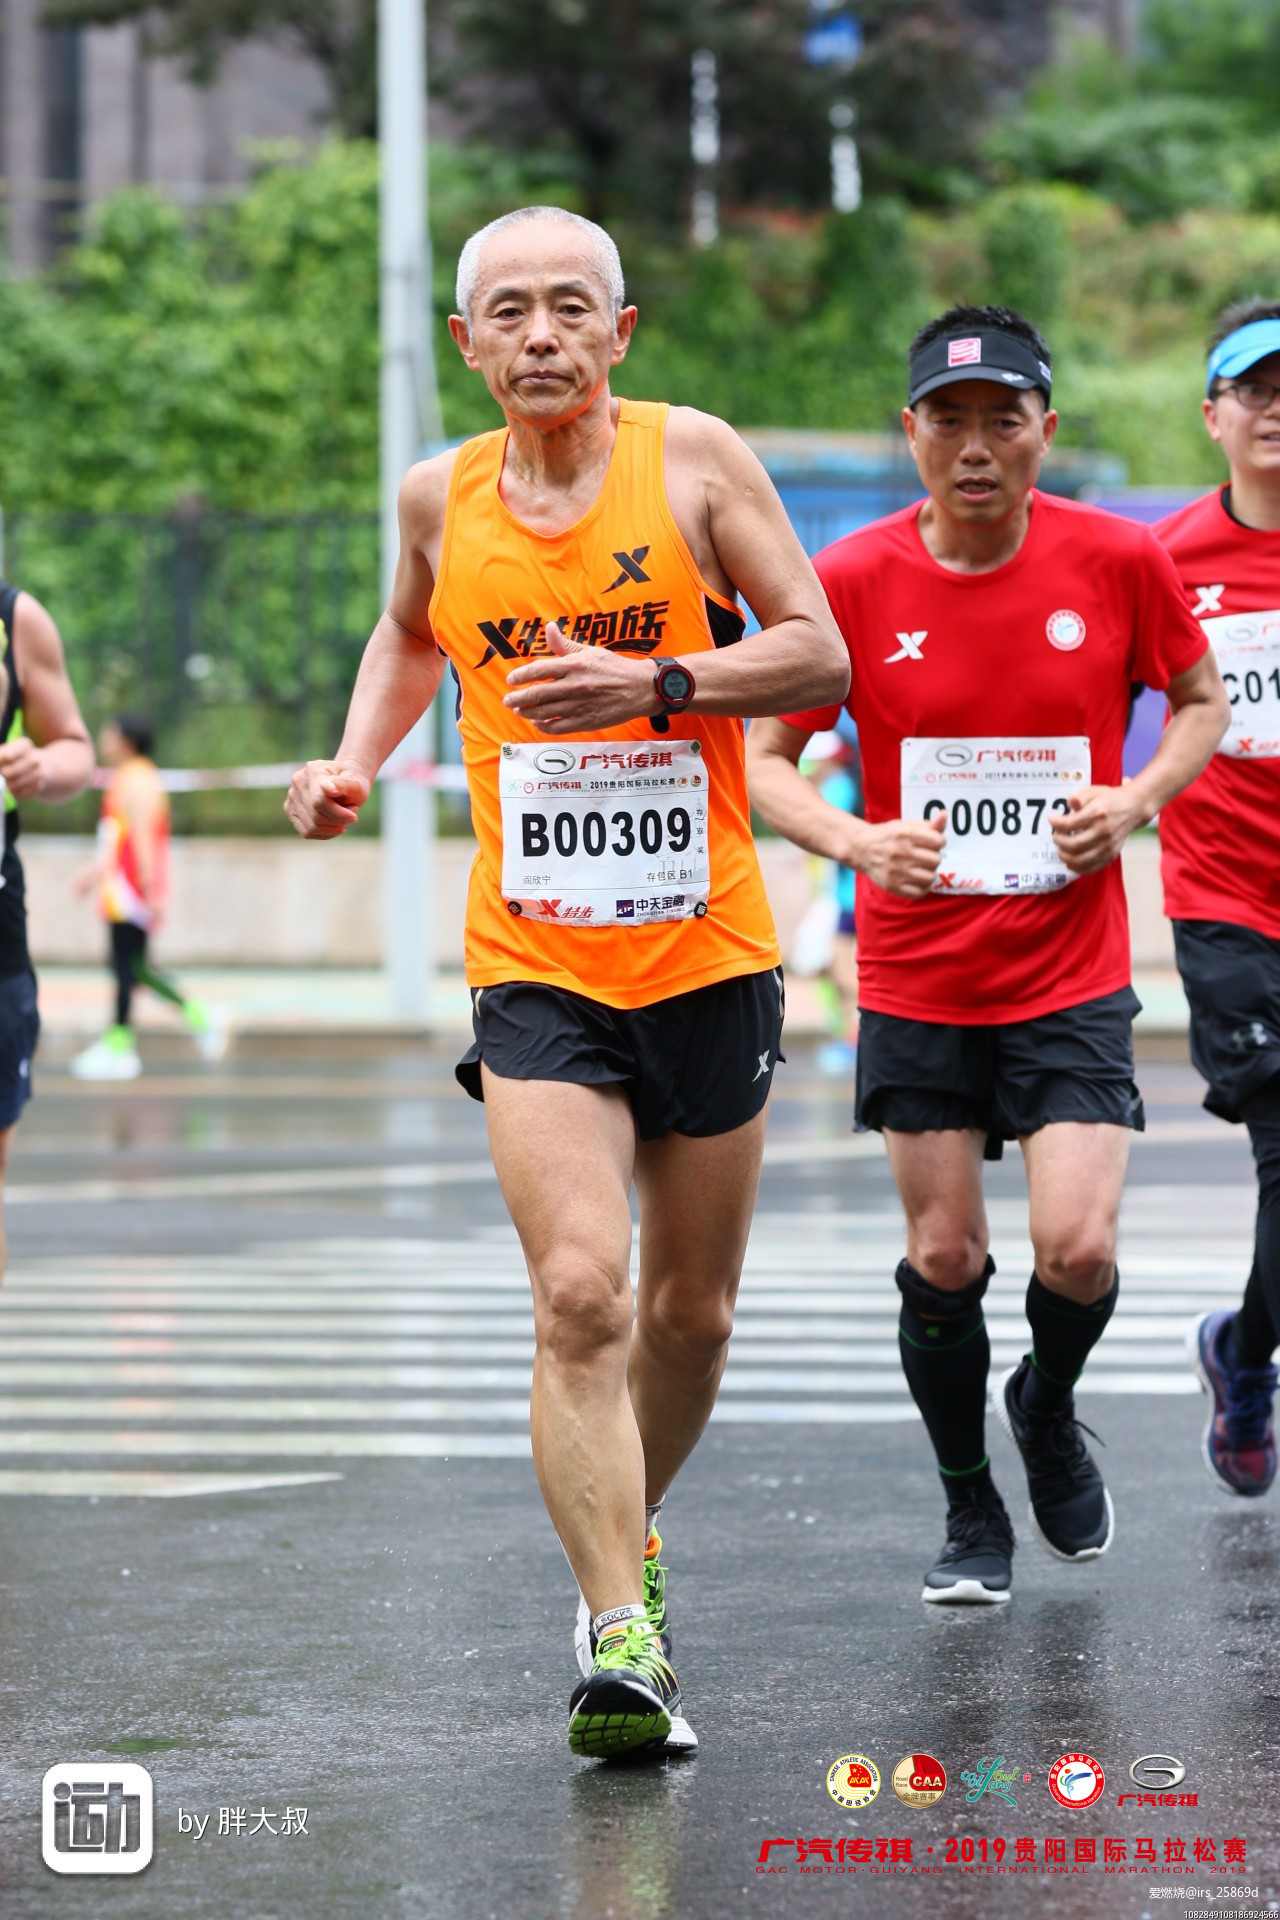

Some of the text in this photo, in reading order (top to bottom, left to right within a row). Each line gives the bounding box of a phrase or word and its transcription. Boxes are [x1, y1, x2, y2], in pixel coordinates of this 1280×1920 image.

[579, 752, 673, 769] 广汽传祺
[521, 807, 691, 857] B00309
[679, 868, 694, 880] B1
[636, 894, 686, 912] 中天金融
[601, 1608, 634, 1624] SOCKS
